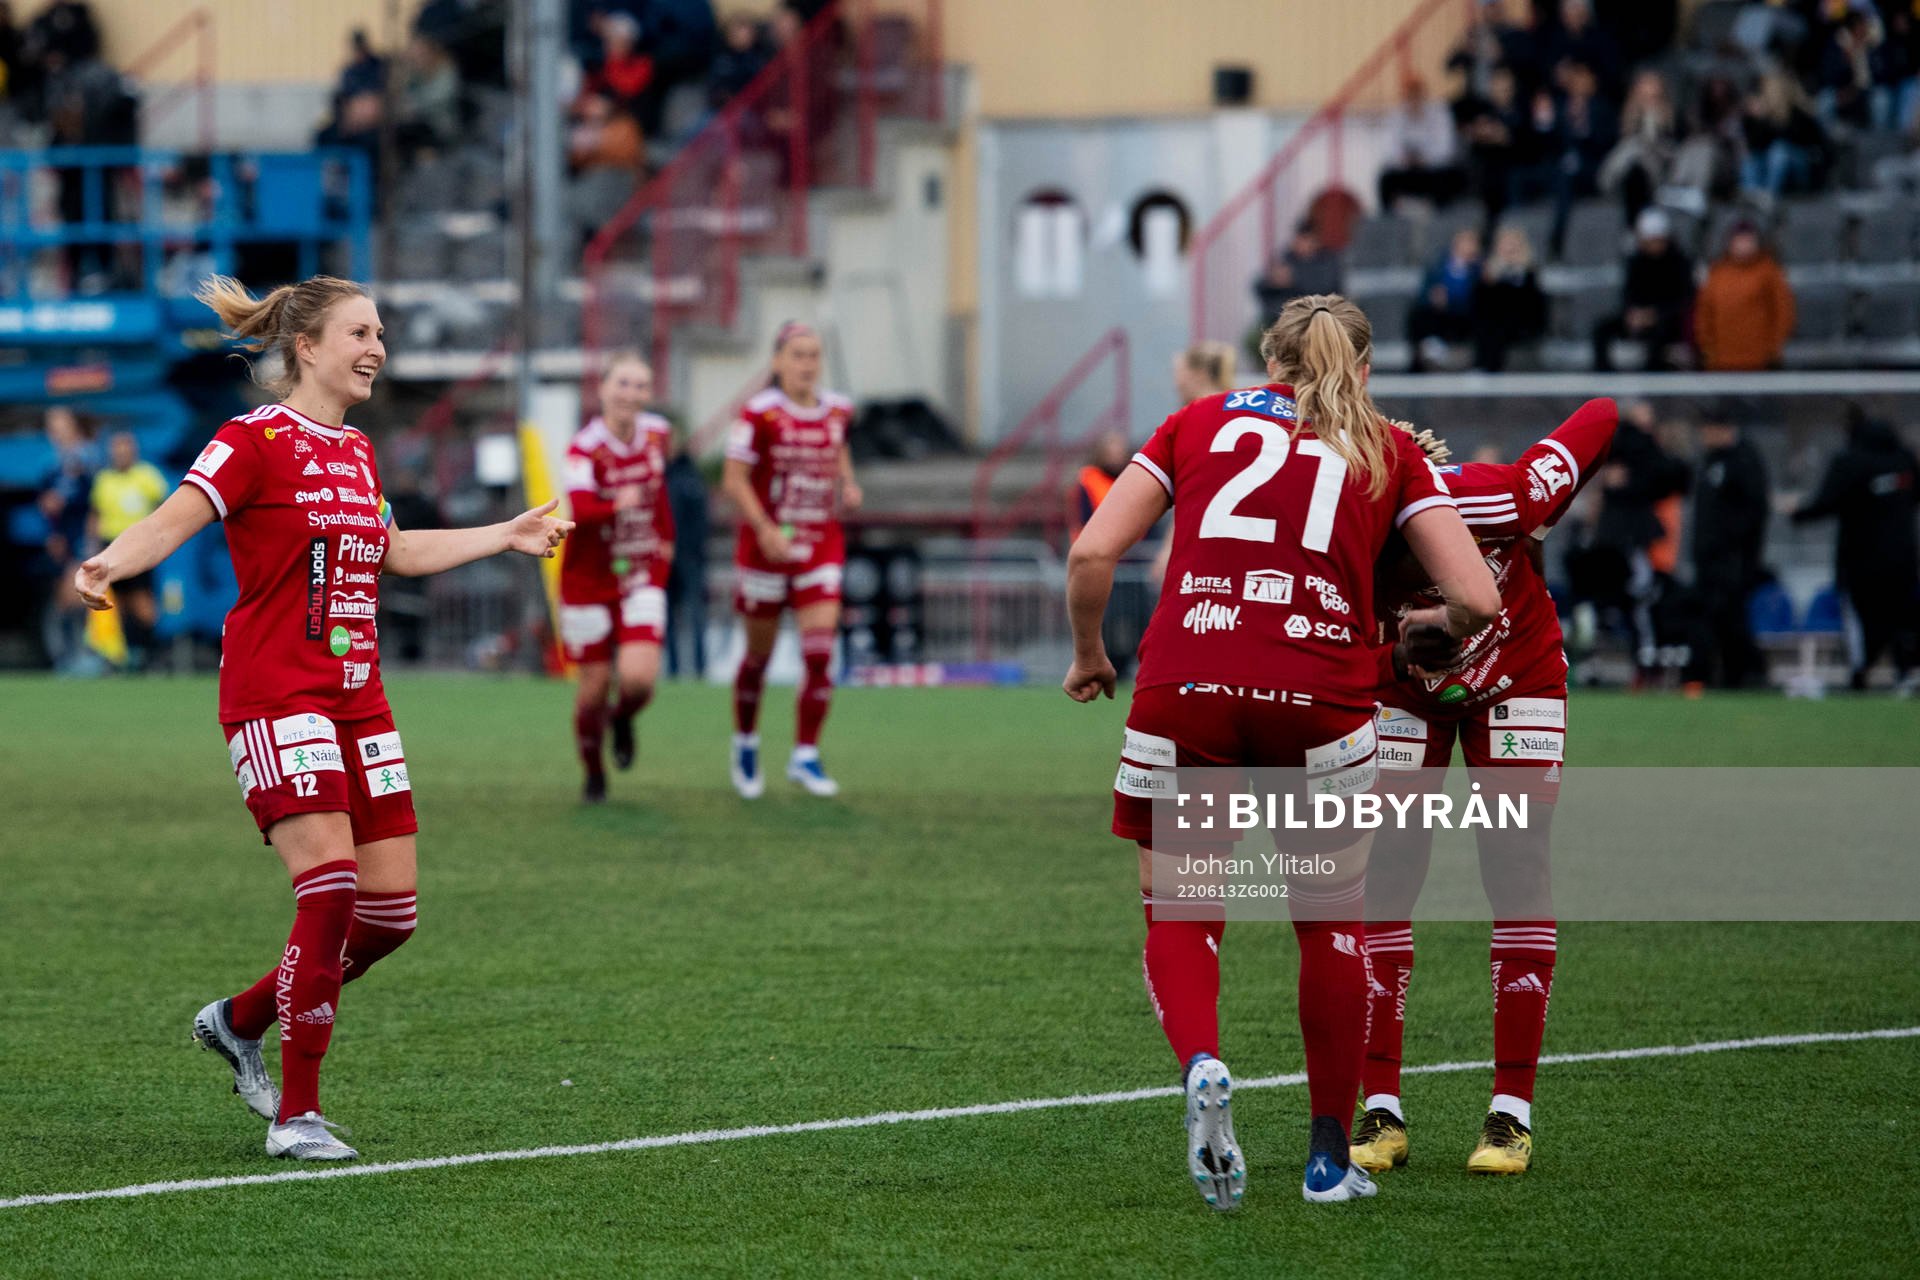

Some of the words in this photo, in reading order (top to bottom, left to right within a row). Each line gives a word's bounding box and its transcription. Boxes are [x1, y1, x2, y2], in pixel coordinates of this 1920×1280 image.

[1199, 416, 1349, 554] 21
[307, 510, 377, 530] Sparbanken
[338, 533, 385, 564] Piteå
[308, 542, 326, 636] sportringen
[1304, 575, 1337, 595] Pite
[1313, 622, 1351, 643] SCA
[1460, 667, 1476, 685] Dina
[290, 773, 320, 798] 12
[276, 943, 301, 1041] WIXNERS
[296, 1014, 336, 1025] adidas
